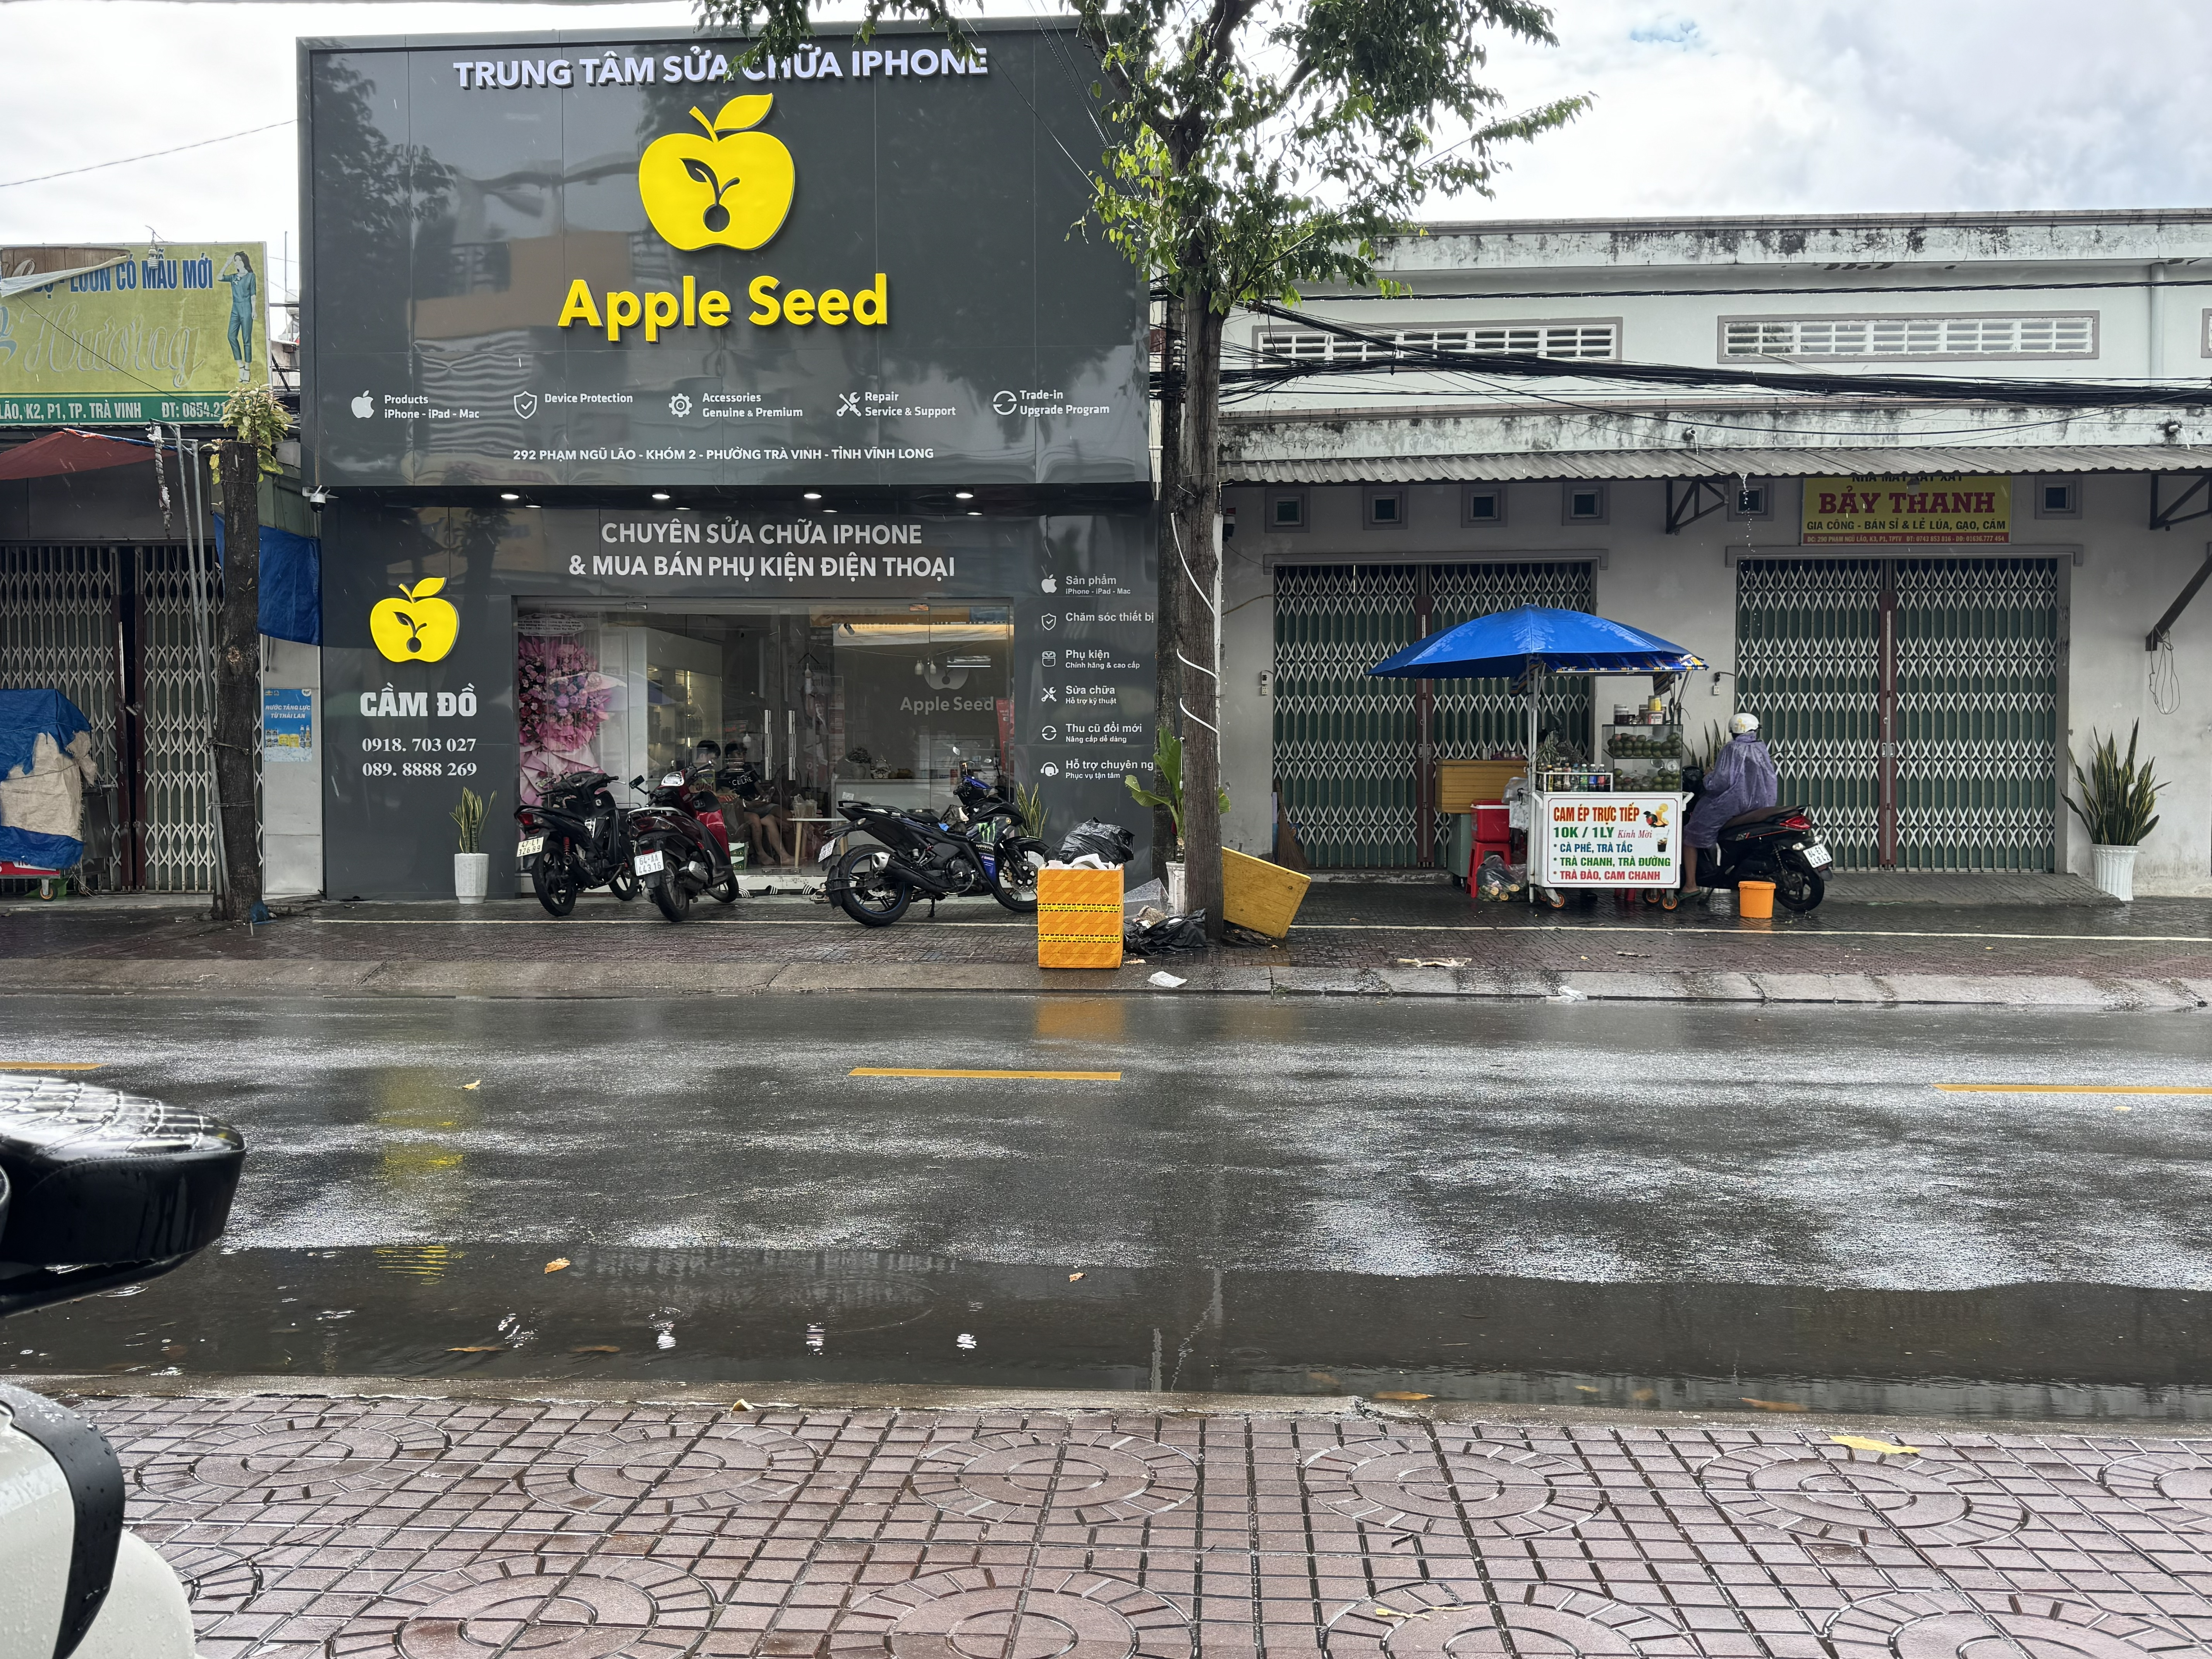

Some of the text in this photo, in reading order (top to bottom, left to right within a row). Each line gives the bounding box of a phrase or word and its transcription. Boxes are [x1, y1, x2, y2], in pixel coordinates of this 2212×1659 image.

[453, 59, 571, 88] TRUNG
[579, 51, 655, 84] TÂM
[663, 47, 729, 82] SỬA
[852, 48, 988, 77] IPHONE
[116, 254, 136, 291] CÓ
[142, 248, 177, 289] MẪU
[182, 252, 213, 289] MỚI
[558, 273, 888, 342] Apple Seed
[385, 394, 429, 404] Products
[544, 393, 633, 403] Device Protection
[702, 392, 761, 402] Accessories
[865, 391, 899, 404] Repair
[1019, 389, 1063, 400] Trade-in
[26, 403, 44, 421] K2,
[47, 403, 66, 421] P1,
[68, 403, 86, 418] TP.
[89, 399, 112, 418] TRÀ
[114, 402, 142, 418] VINH
[182, 402, 226, 418] 0854.21
[385, 409, 479, 419] iPhone iPad Mac
[702, 407, 745, 417] Genuine
[756, 407, 803, 417] Premium
[865, 406, 956, 418] Service & Support
[1020, 404, 1109, 417] Upgrade Program
[513, 446, 934, 462] 292 PHẠM NGŨ LÃO KHÓM 2 PHƯỜNG TRÀ VINH TỈNH VĨNH LONG
[1819, 485, 1995, 514] BẢY THANH
[601, 516, 922, 545] CHUYÊN SỬA CHỮA IPHONE
[1807, 521, 1823, 530] GIA
[1827, 519, 1855, 530] CÔNG
[1864, 519, 1886, 529] BÁN
[1901, 520, 1910, 529] &
[1929, 519, 1953, 531] LÚA,
[1956, 521, 1979, 531] GẠO,
[1983, 518, 2006, 529] CÁM
[569, 551, 955, 582] & MUA BÁN PHỤ KIỆN ĐIỆN THOẠI
[1065, 610, 1154, 623] Chăm sóc thiết bị
[1066, 649, 1109, 661] Phụ kiện
[1089, 685, 1115, 694] chữa
[360, 682, 477, 716] CẦM ĐỒ
[900, 696, 994, 715] Apple Seed
[1065, 723, 1085, 733] Thu
[1088, 724, 1100, 732] cũ
[1122, 723, 1142, 732] mới
[362, 738, 476, 752] 0918. 703 027
[362, 763, 477, 776] 089. 8888 269
[1066, 758, 1080, 769] Hỗ
[1082, 761, 1098, 771] trợ
[1101, 760, 1138, 771] chuyên
[1554, 802, 1640, 825] CAM ÉP TRỰC TIẾP
[1553, 827, 1614, 838] 10K 1LY
[1618, 829, 1652, 838] Kính Mời
[1560, 840, 1633, 854] CÀ PHÊ, TRÀ TẮC
[1560, 855, 1671, 867] TRÀ CHANH, TRÀ ĐƯỜNG
[1559, 869, 1660, 881] TRÀ ĐÀO, CAM CHANH
